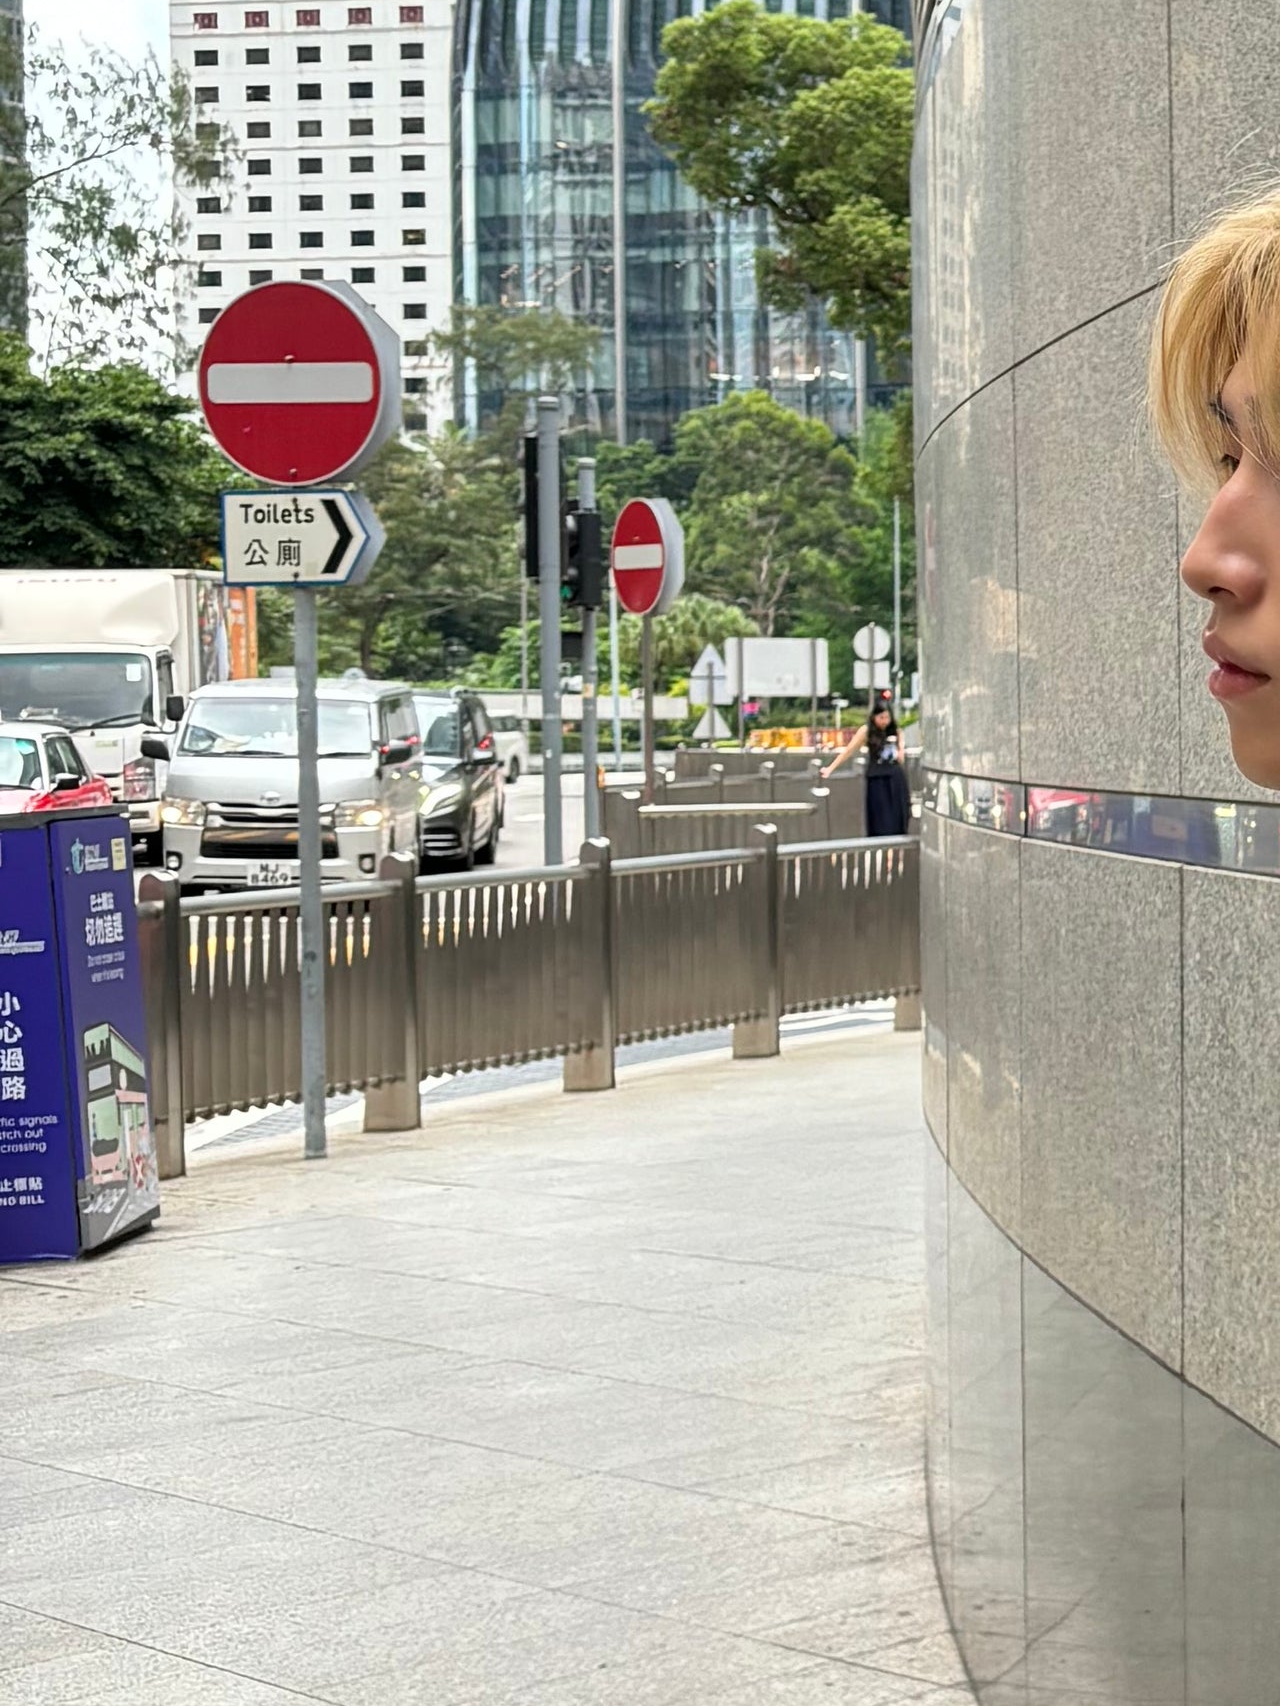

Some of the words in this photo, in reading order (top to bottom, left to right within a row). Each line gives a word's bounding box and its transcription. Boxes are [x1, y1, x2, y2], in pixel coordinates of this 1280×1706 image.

[239, 503, 315, 524] Toilets
[243, 538, 302, 567] 公廁
[260, 863, 279, 874] MJ
[24, 1128, 44, 1139] out
[19, 1194, 45, 1206] BILL
